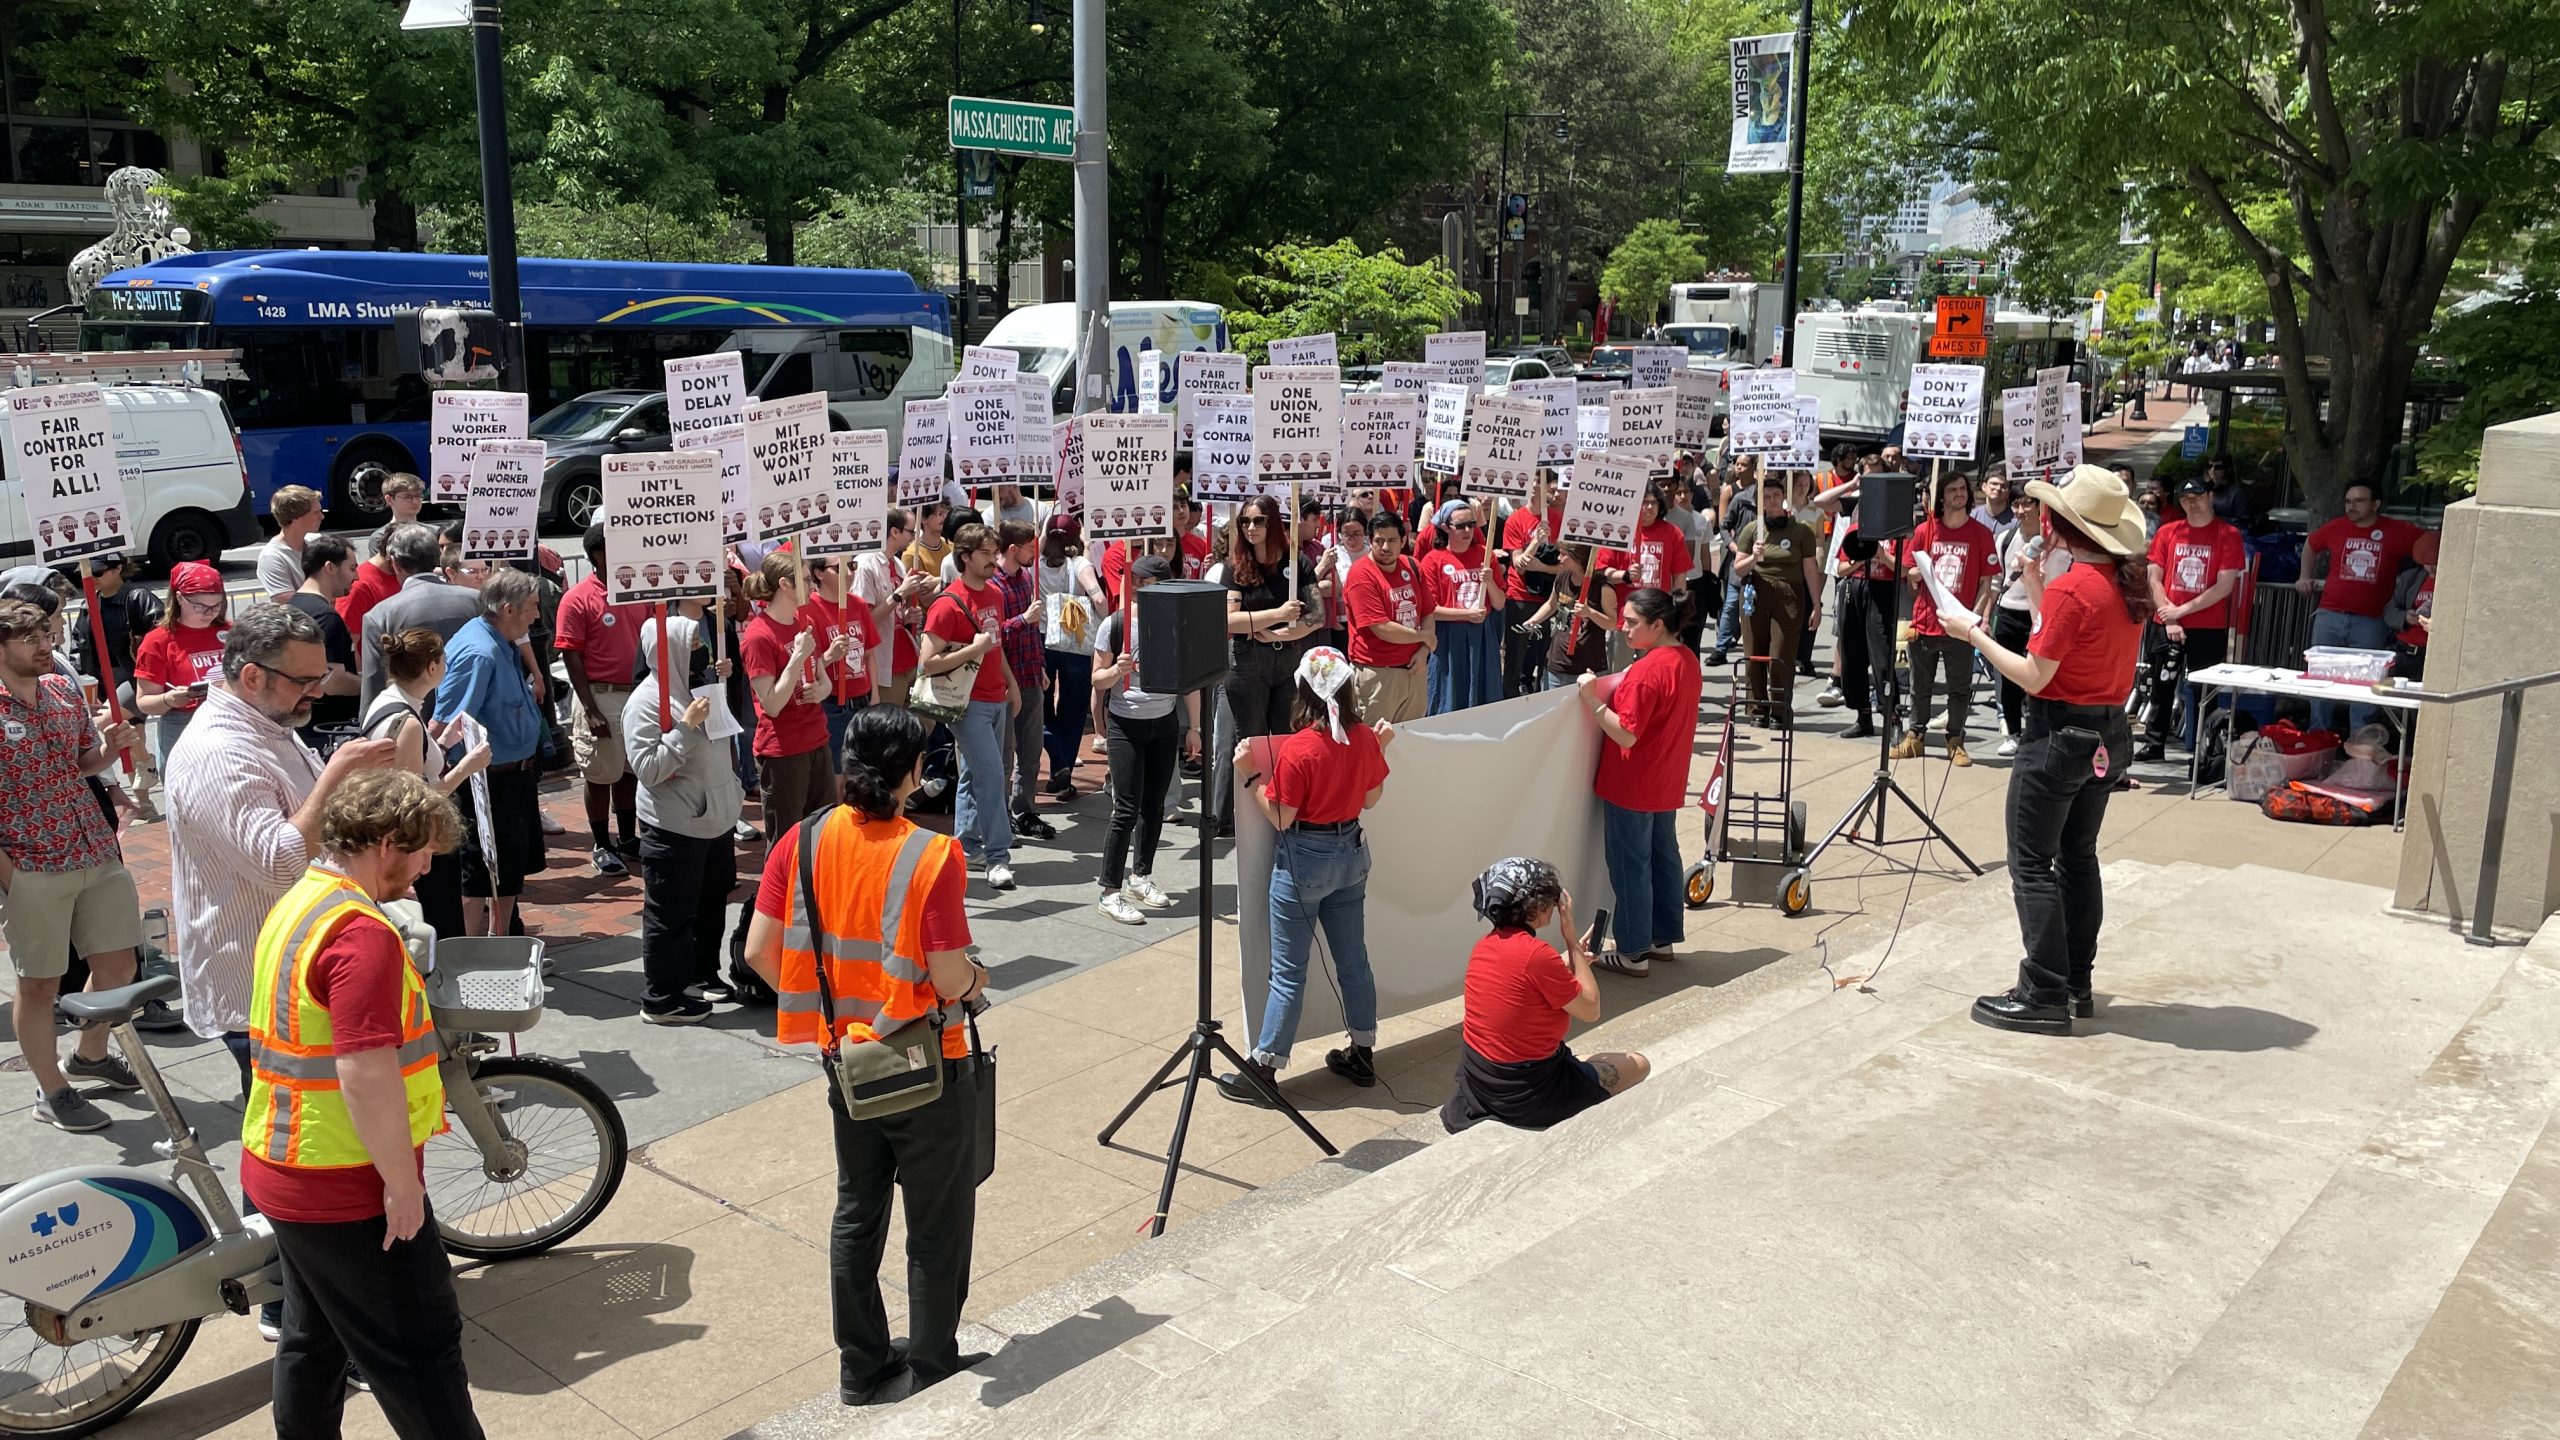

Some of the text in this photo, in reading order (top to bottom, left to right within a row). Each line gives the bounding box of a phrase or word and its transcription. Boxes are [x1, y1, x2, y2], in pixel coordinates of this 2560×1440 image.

[1734, 40, 1761, 56] MIT
[954, 110, 1072, 146] MASSACHUSETTS AVE
[974, 186, 993, 195] TIME
[112, 290, 182, 310] M-2 SHUTTLE
[1941, 300, 1981, 309] DETOUR
[257, 307, 286, 318] 1428
[308, 302, 350, 318] LMA
[1936, 341, 1981, 352] AMES ST
[1292, 352, 1316, 361] FAIR
[670, 363, 682, 372] UE
[973, 365, 1007, 379] DON'T
[1914, 366, 1928, 375] UE
[1201, 370, 1225, 379] FAIR
[682, 375, 729, 392] DON'T
[1184, 380, 1240, 390] CONTRACT
[1923, 380, 1968, 392] DON'T
[953, 386, 965, 394] UE
[1282, 388, 1312, 398] ONE
[14, 398, 28, 410] UE
[70, 390, 98, 399] GRADUATE
[438, 397, 454, 405] UE
[1743, 392, 1780, 400] WORKER
[54, 398, 77, 407] STUDENT
[684, 393, 731, 411] DELAY
[975, 399, 1003, 409] ONE
[1271, 400, 1322, 412] UNION,
[1434, 399, 1456, 410] DON'T
[1734, 402, 1792, 411] PROTECTIONS
[1922, 396, 1965, 409] DELAY
[1622, 404, 1664, 416] DON'T
[464, 413, 498, 422] INT'L
[749, 411, 763, 421] UE
[965, 410, 1015, 422] UNION,
[1023, 416, 1047, 424] CONTRACT
[1217, 415, 1247, 424] FAIR
[1281, 412, 1311, 423] ONE
[1368, 412, 1394, 420] FAIR
[1434, 414, 1455, 424] DELAY
[1495, 415, 1521, 426] FAIR
[1750, 415, 1775, 423] NOW!
[1908, 412, 1977, 425] NEGOTIATE
[41, 416, 80, 436] FAIR
[452, 425, 506, 433] WORKER
[917, 419, 935, 428] FAIR
[976, 422, 1005, 432] ONE
[1090, 419, 1105, 428] UE
[1351, 422, 1410, 430] CONTRACT
[1623, 419, 1663, 431] DELAY
[775, 423, 800, 439] MIT
[1273, 428, 1320, 438] FIGHT!
[1369, 432, 1391, 440] FOR
[1426, 429, 1460, 441] NEGOTIATE
[1476, 425, 1536, 439] CONTRACT
[24, 432, 104, 457] CONTRACT
[908, 435, 944, 447] CONTRACT
[970, 434, 1015, 446] FIGHT!
[1116, 437, 1143, 448] MIT
[1493, 437, 1515, 447] FOR
[1610, 435, 1673, 446] NEGOTIATE
[753, 434, 825, 459] WORKERS
[1364, 444, 1398, 454] ALL!
[1092, 450, 1167, 461] WORKERS
[1211, 454, 1250, 465] NOW
[1488, 448, 1522, 461] ALL!
[1581, 453, 1593, 461] UE
[50, 454, 85, 472] FOR
[496, 461, 522, 470] INT'L
[763, 450, 813, 471] WON'T
[910, 456, 937, 469] NOW!
[608, 462, 628, 472] UE
[1101, 464, 1153, 475] WON'T
[487, 474, 528, 484] WORKER
[773, 467, 811, 486] WAIT
[1595, 469, 1623, 481] FAIR
[52, 473, 100, 498] ALL!
[641, 479, 683, 493] INT'L
[1111, 480, 1148, 491] WAIT
[1578, 481, 1636, 498] CONTRACT
[472, 488, 536, 498] PROTECTIONS
[628, 495, 695, 509] WORKER
[490, 507, 518, 516] NOW!
[1582, 501, 1624, 516] NOW!
[611, 510, 715, 527] PROTECTIONS
[642, 534, 688, 547] NOW!
[2345, 542, 2380, 550] UNION
[1932, 544, 1968, 556] UNION
[2176, 548, 2209, 558] UNION
[1391, 588, 1414, 602] UNION
[8, 1220, 113, 1265] MASSACHUSETTS
[46, 1270, 90, 1292] electrified
